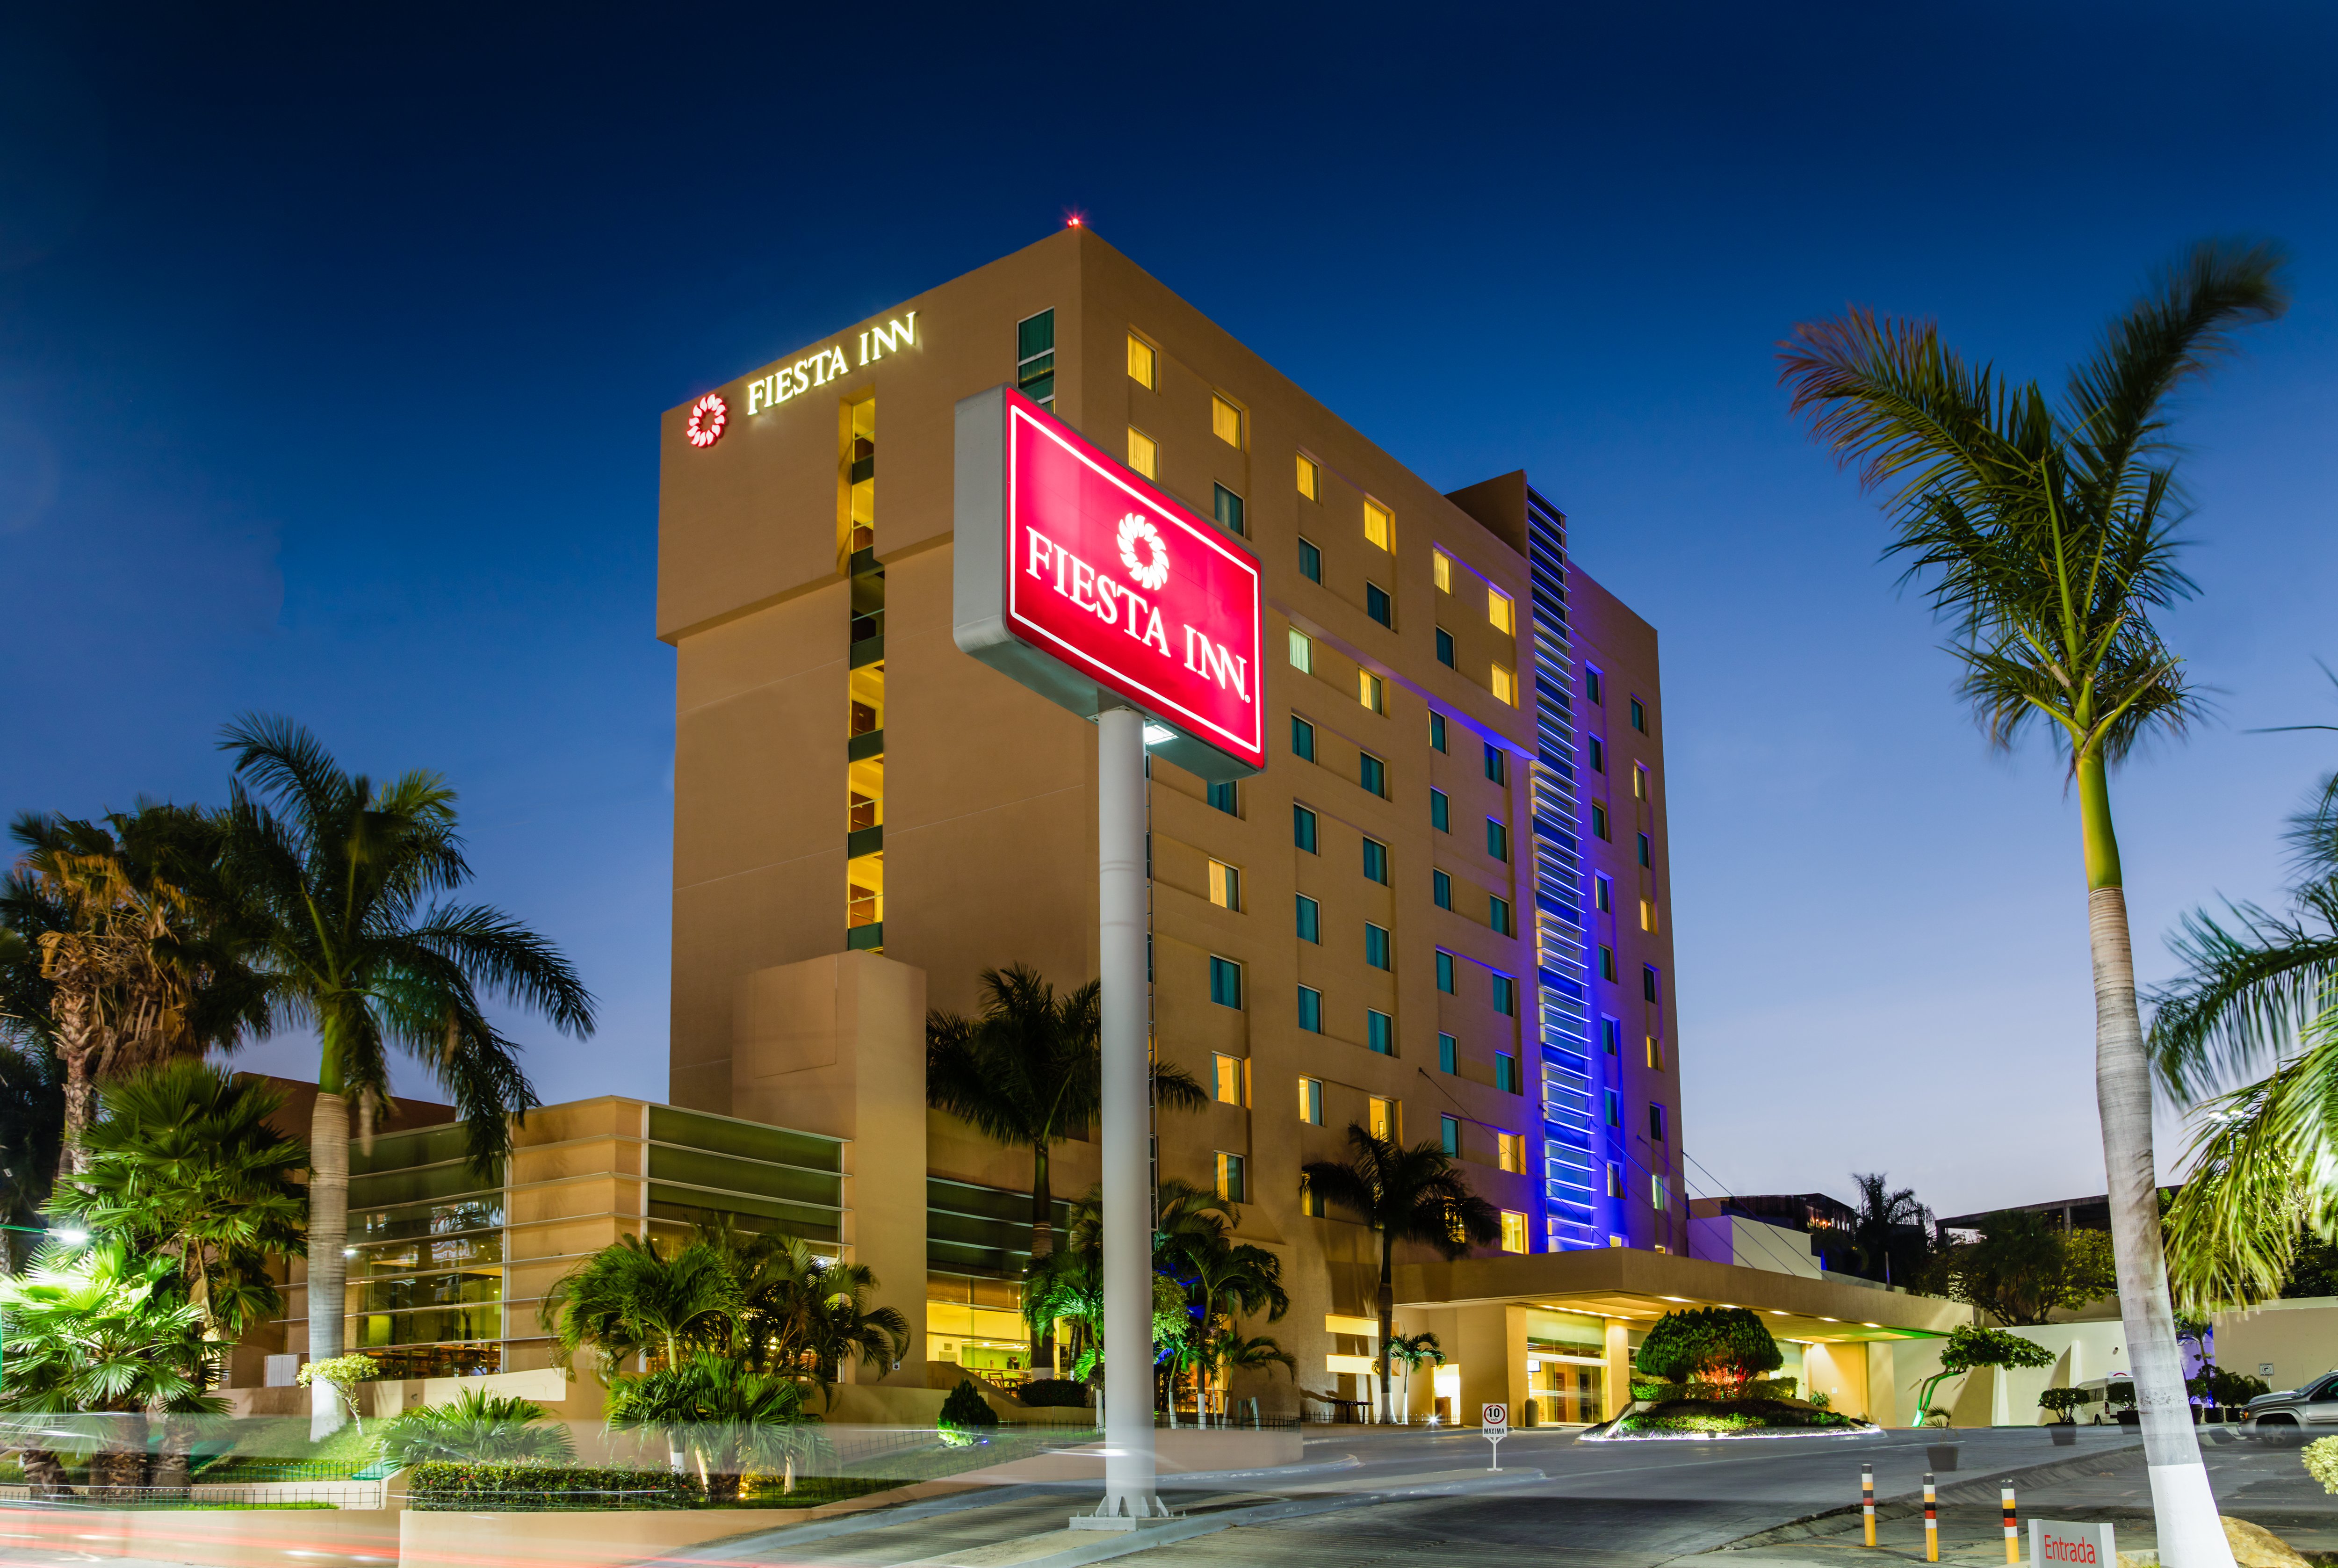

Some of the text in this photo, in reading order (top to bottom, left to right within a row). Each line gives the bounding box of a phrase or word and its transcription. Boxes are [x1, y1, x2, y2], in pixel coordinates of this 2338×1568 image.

[747, 311, 916, 416] FIESTA INN
[1025, 525, 1247, 701] FIESTA INN
[1489, 1408, 1500, 1417] 10
[2044, 1534, 2096, 1564] Entrada
